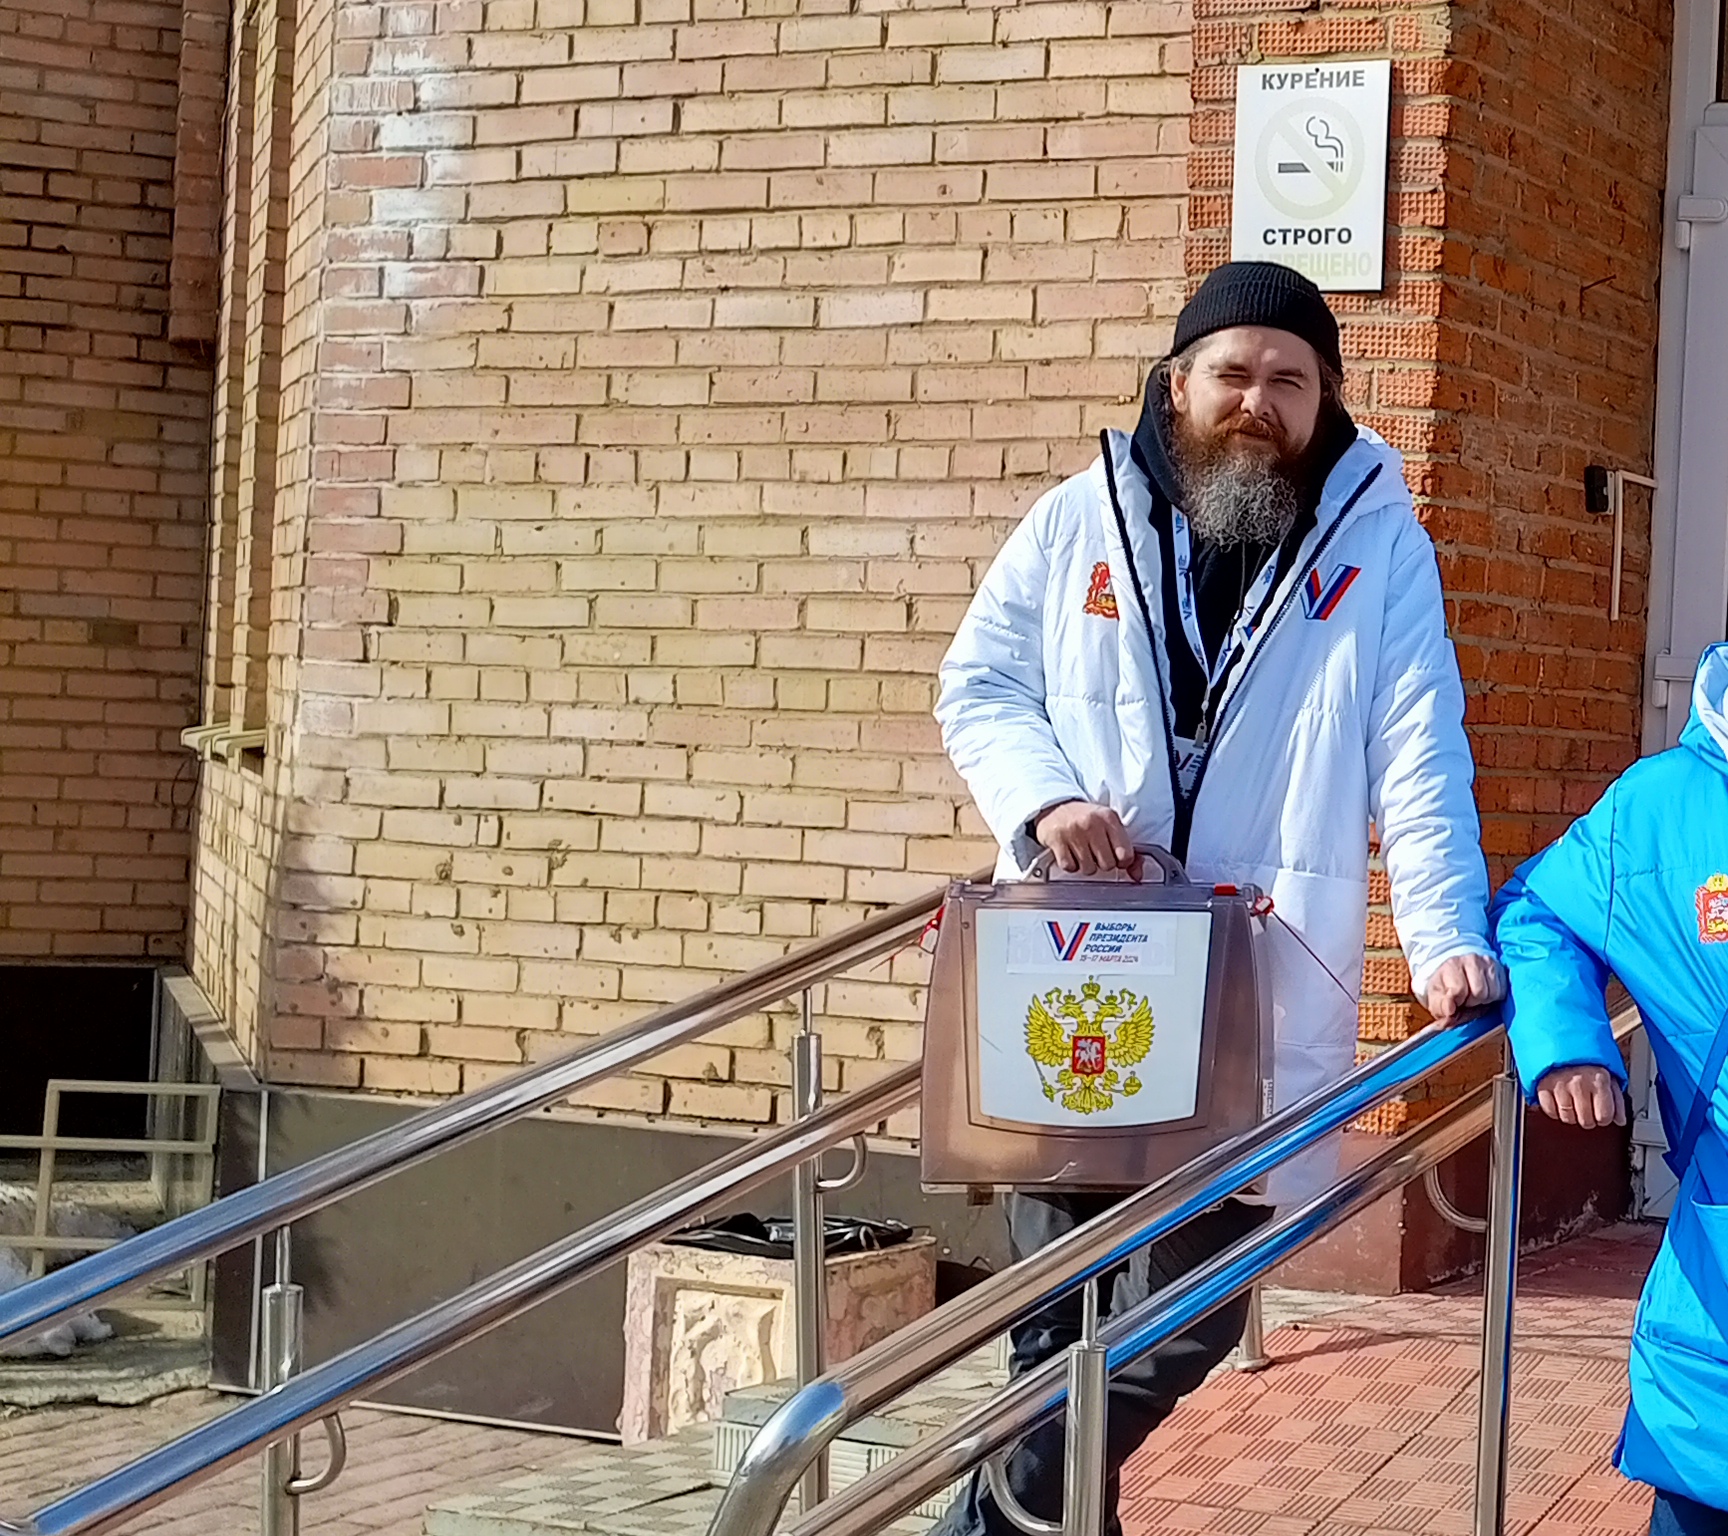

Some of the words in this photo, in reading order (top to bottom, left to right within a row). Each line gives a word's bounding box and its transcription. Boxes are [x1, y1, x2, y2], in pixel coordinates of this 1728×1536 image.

[1261, 69, 1366, 90] КУРЕНИЕ
[1262, 227, 1353, 246] СТРОГО
[1094, 922, 1138, 932] ВЫБОРЫ
[1088, 933, 1149, 943] ПРЕЗИДЕНТА
[1083, 944, 1123, 953] РОССИИ
[1098, 954, 1122, 963] МАРТА
